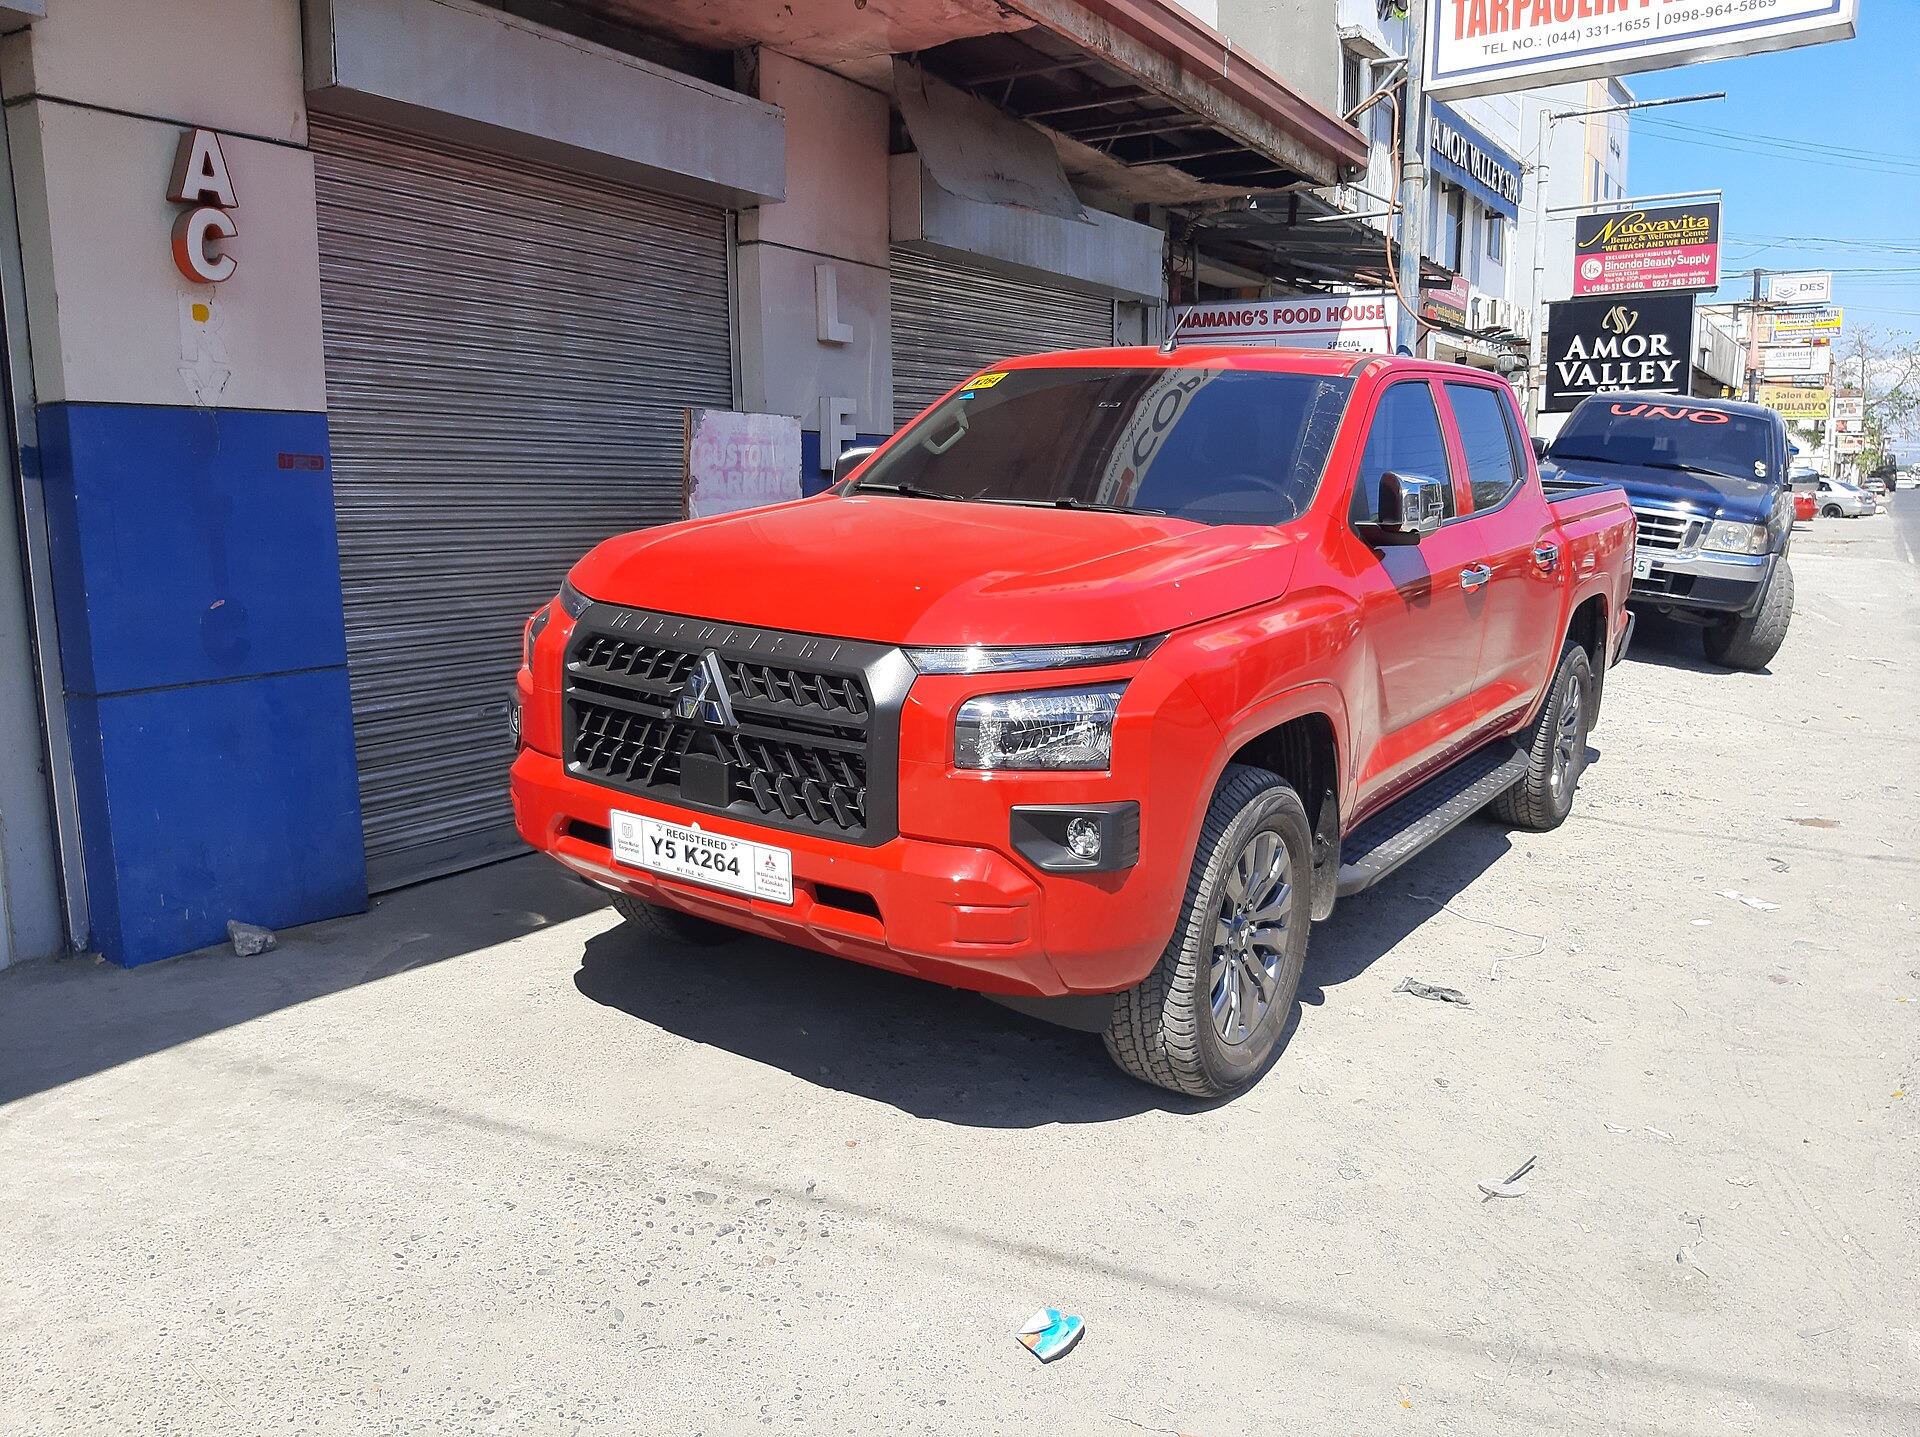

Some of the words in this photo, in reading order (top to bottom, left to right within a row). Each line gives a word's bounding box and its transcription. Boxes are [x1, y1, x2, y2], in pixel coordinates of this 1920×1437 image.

[1482, 43, 1508, 56] TEL
[1512, 36, 1542, 51] NO.:
[1546, 28, 1581, 47] (044)
[1586, 17, 1650, 39] 331-1655
[1664, 0, 1776, 25] 0998-964-5869
[1431, 117, 1468, 171] AMOR
[1468, 142, 1504, 195] VALLEY
[1503, 170, 1519, 206] SPA
[1578, 212, 1710, 248] Nuovavita
[1611, 235, 1637, 244] Beauty
[1647, 232, 1681, 240] Wellness
[1682, 230, 1709, 238] Center
[1605, 253, 1634, 261] EXCLUSIVE
[1635, 251, 1672, 259] DISTRIBUTOR
[1619, 242, 1644, 251] TEACH
[1646, 240, 1663, 248] AND
[1605, 258, 1642, 271] Binondo
[1643, 256, 1676, 269] Beauty
[1677, 253, 1710, 266] Supply
[1800, 283, 1824, 291] DES
[1177, 309, 1268, 329] MAMANG'S
[1273, 306, 1322, 325] FOOD
[1326, 304, 1385, 322] HOUSE
[1327, 340, 1361, 350] SPECIAL
[1563, 334, 1673, 361] AMOR
[1554, 359, 1681, 387] VALLEY
[1775, 391, 1801, 400] Salon
[1804, 391, 1817, 399] de
[1610, 403, 1730, 425] UNO
[666, 828, 727, 851] REGISTERED
[650, 835, 677, 859] Y5
[684, 844, 740, 877] K264
